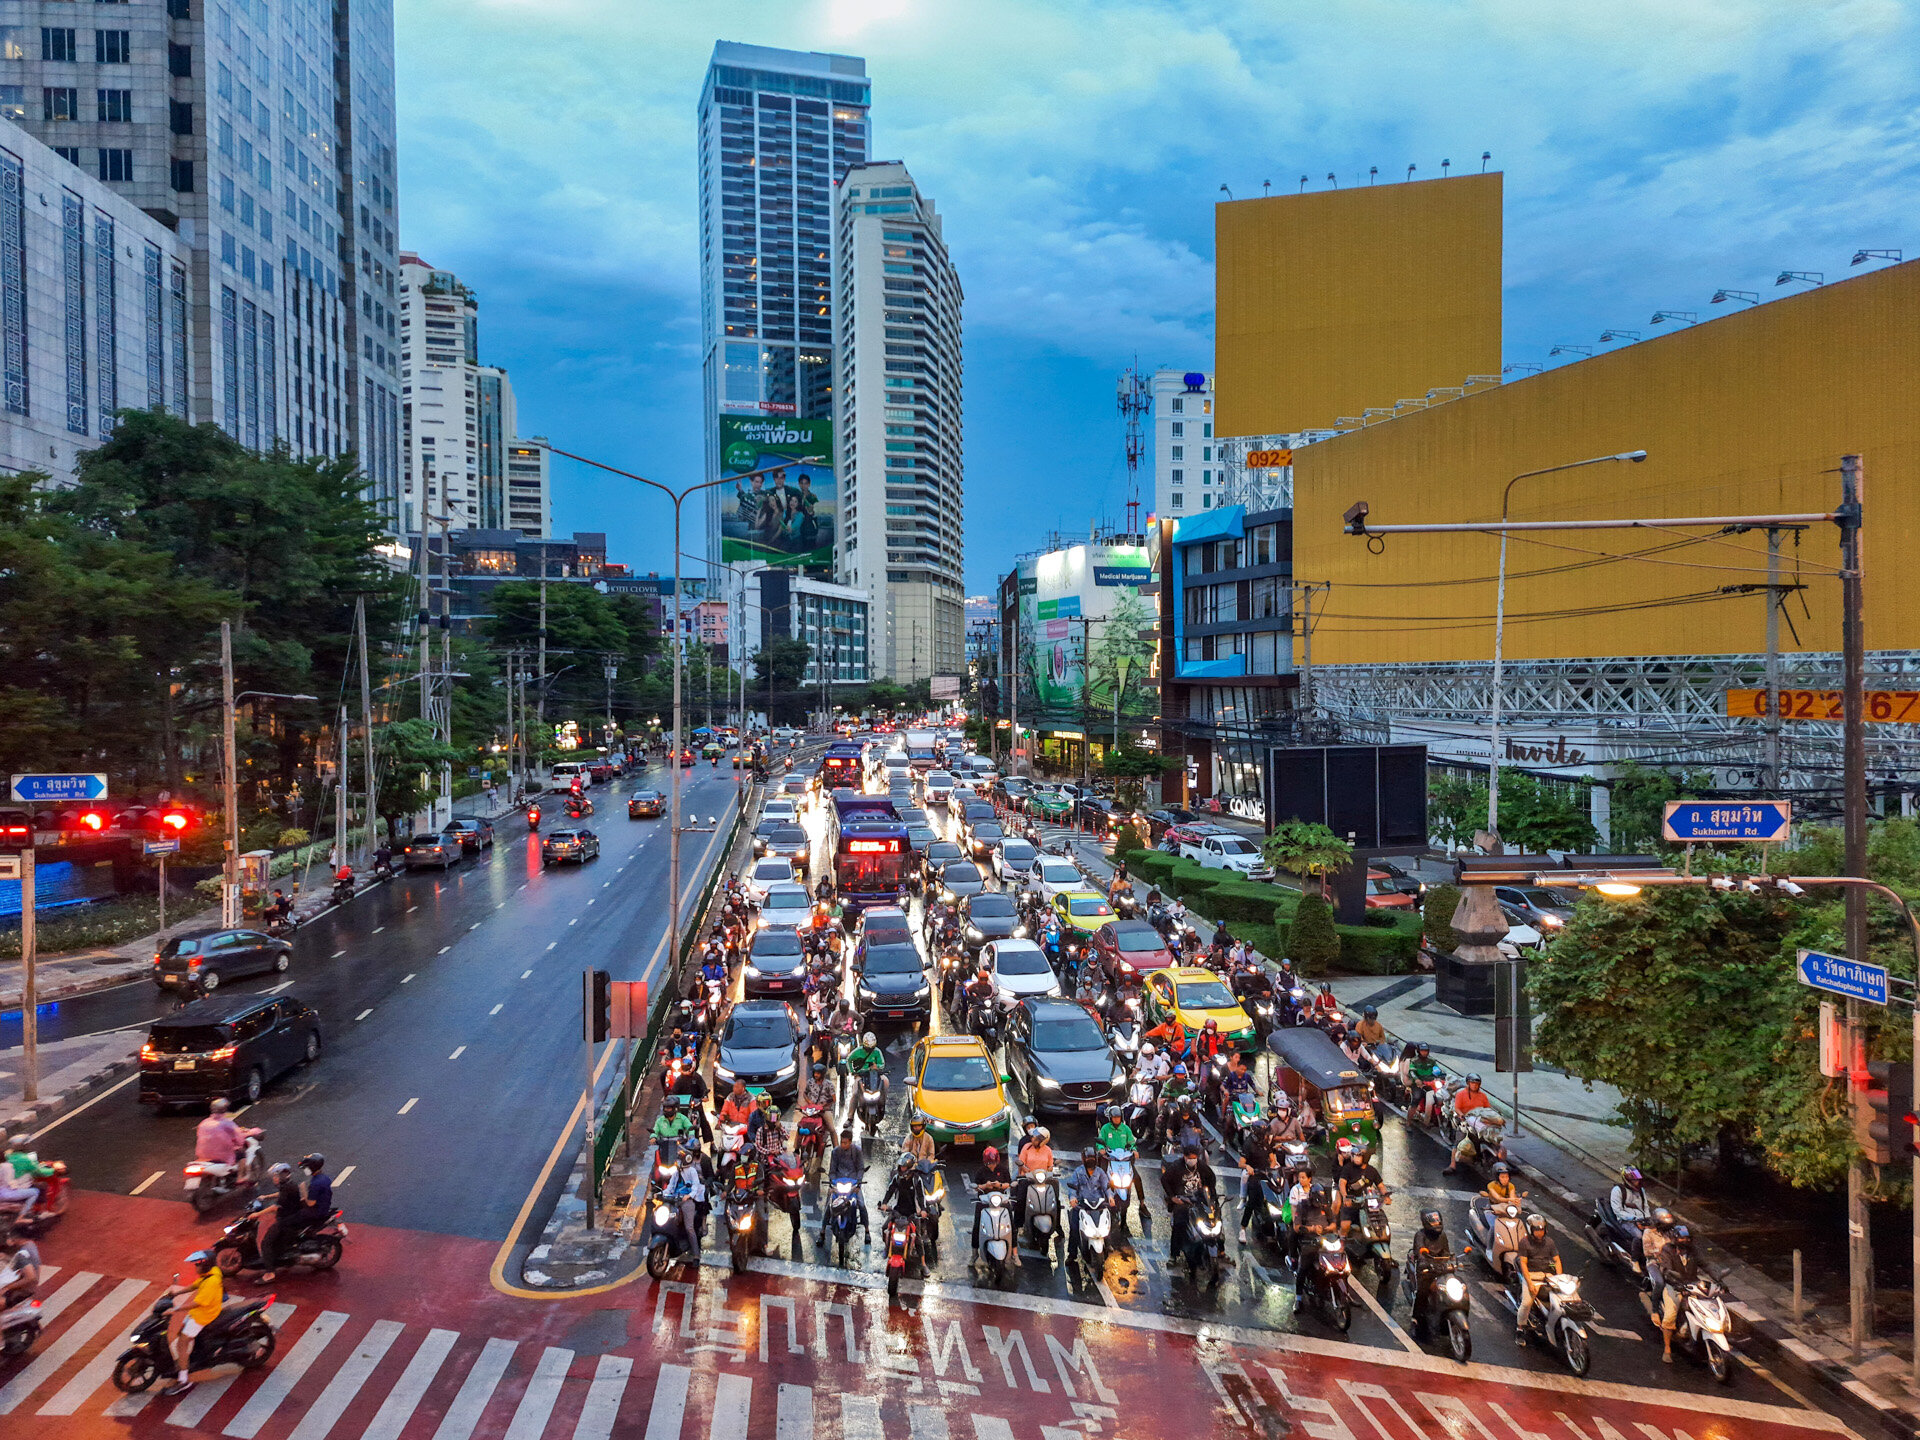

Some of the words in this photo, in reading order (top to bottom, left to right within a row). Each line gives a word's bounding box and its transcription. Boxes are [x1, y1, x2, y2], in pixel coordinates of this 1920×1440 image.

[729, 456, 754, 468] Chang
[1121, 573, 1147, 581] Marijuana
[1505, 735, 1585, 764] Invite
[47, 777, 87, 791] สุขุมวิท
[1691, 812, 1704, 823] ถ.
[1710, 806, 1762, 827] สุขุมวิท
[1692, 827, 1738, 835] Sukhumvit
[1745, 827, 1760, 835] Rd.
[1812, 960, 1822, 972] ถ.
[1824, 958, 1884, 987] รัชดาภิเษก
[1816, 975, 1864, 994] Ratchadaphisek
